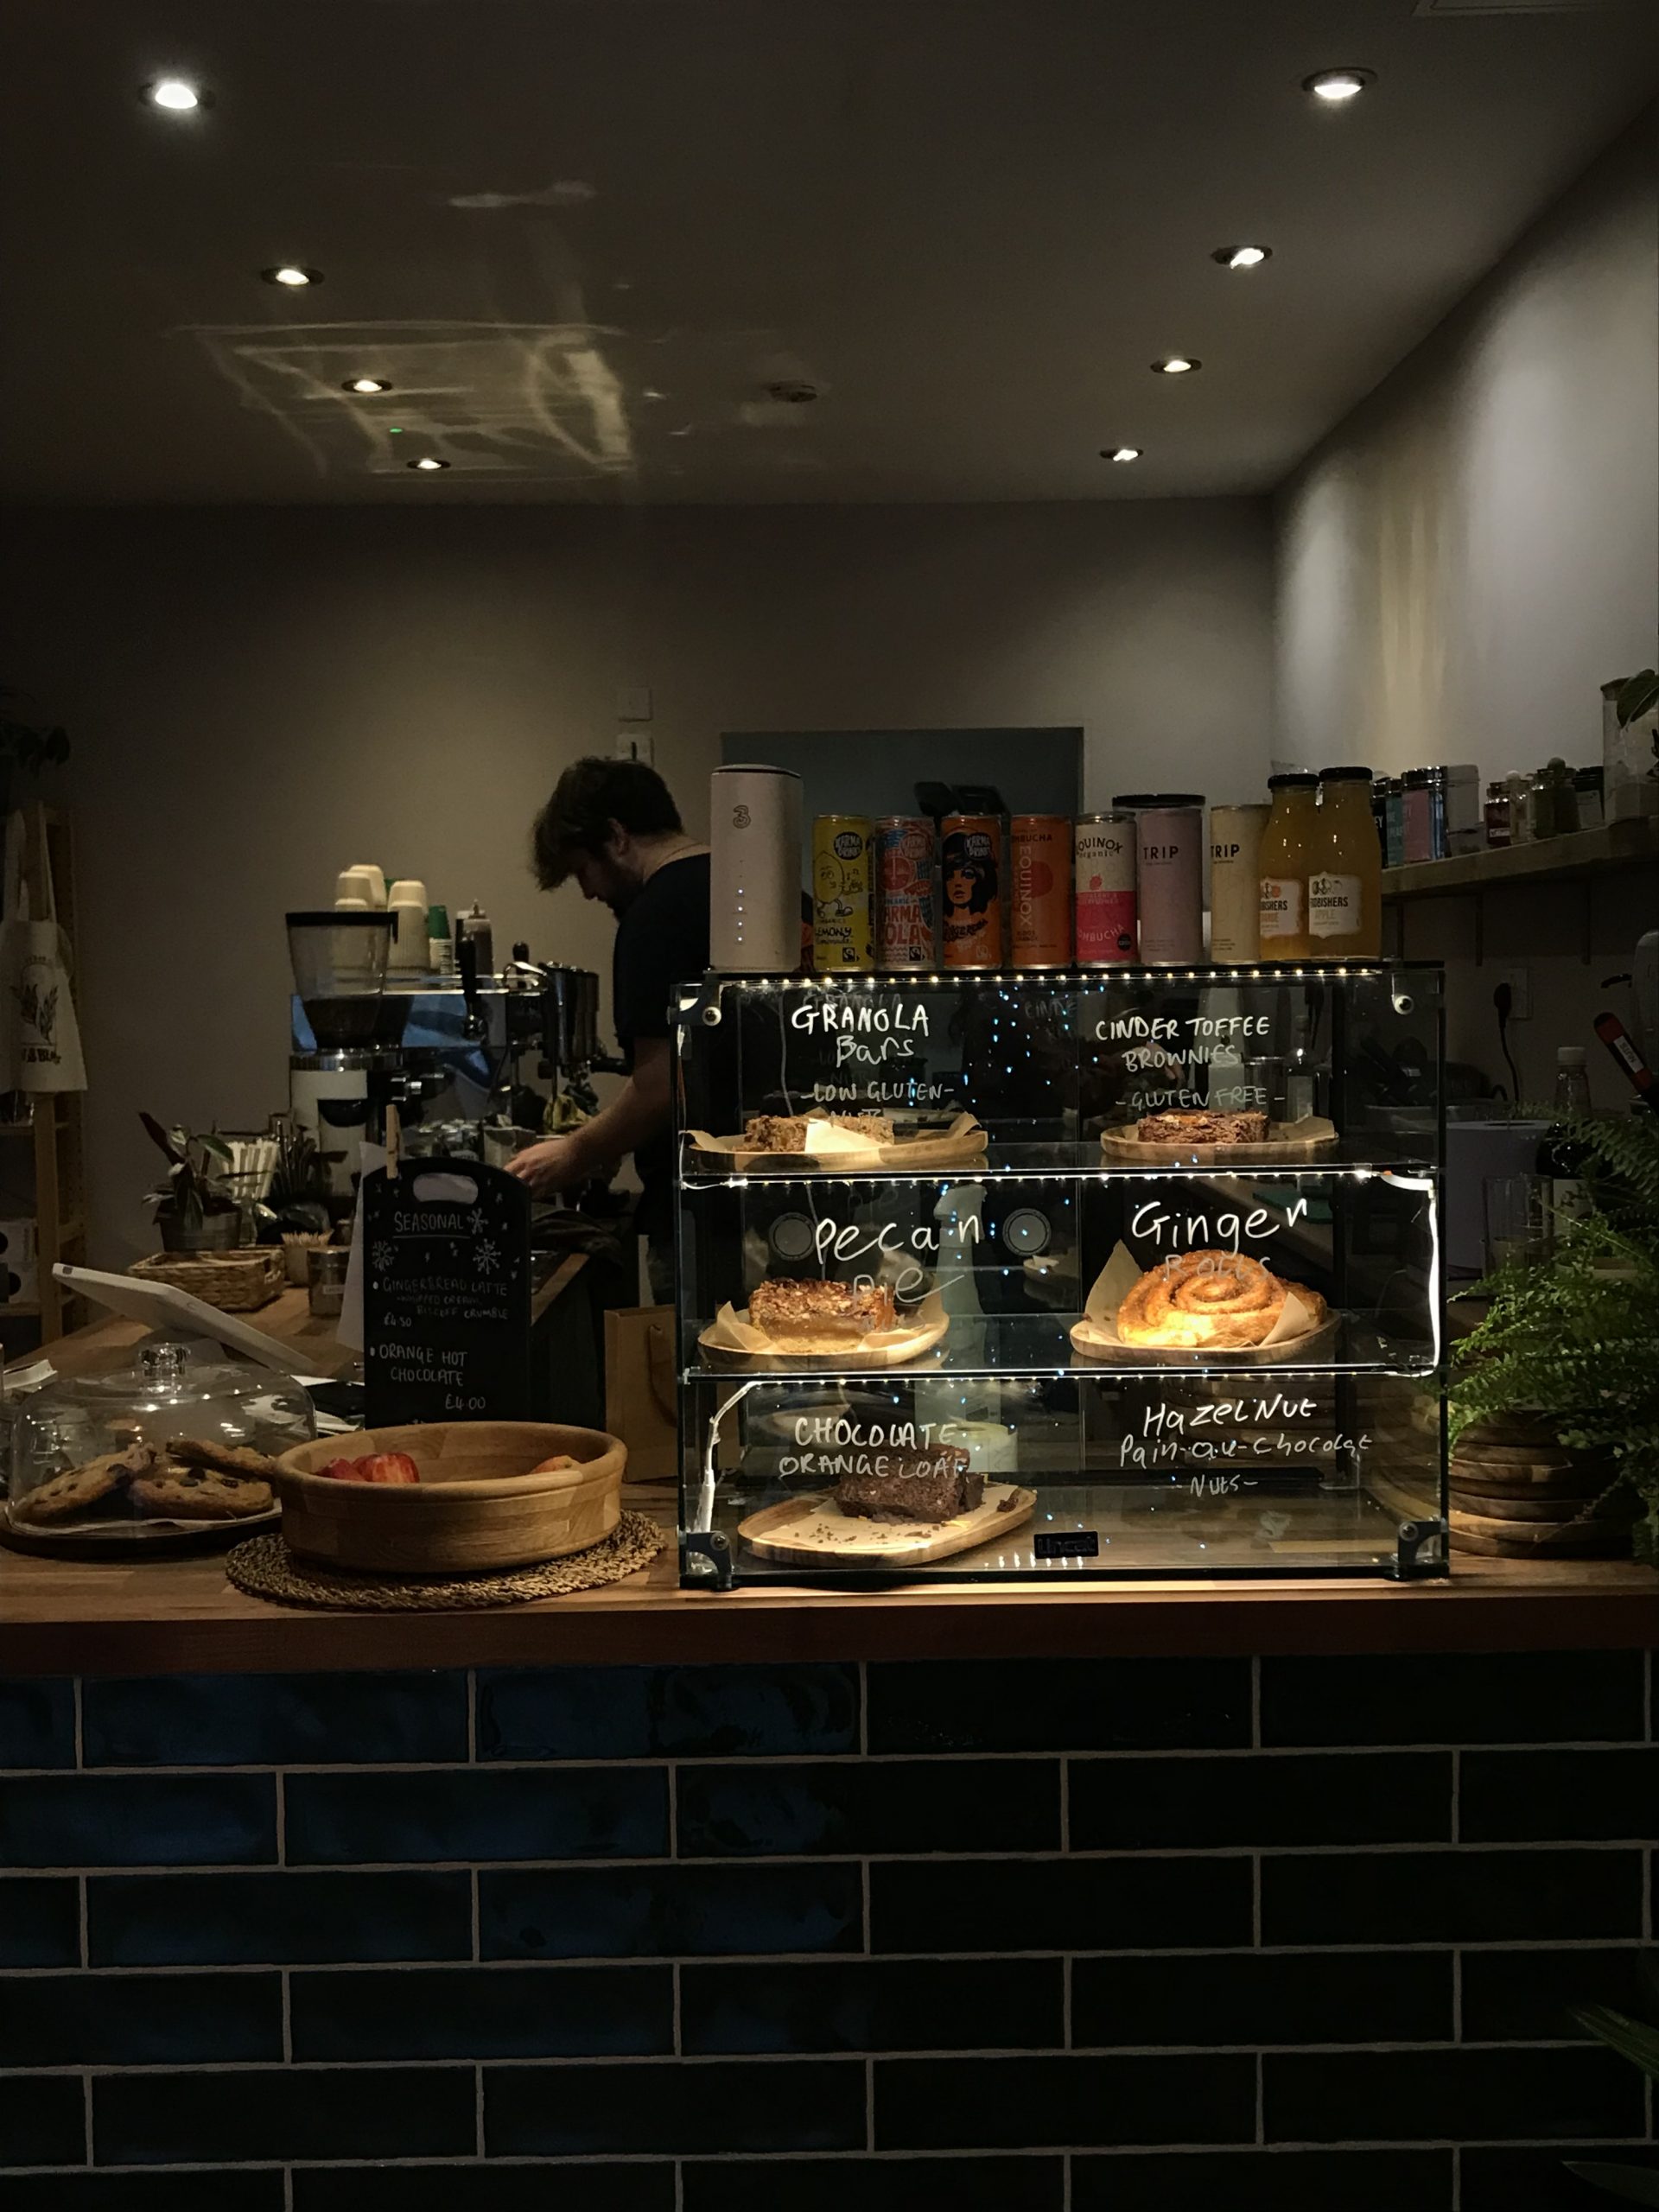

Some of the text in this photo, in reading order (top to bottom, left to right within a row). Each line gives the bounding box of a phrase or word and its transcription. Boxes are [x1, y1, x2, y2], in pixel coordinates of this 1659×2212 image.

[1077, 836, 1123, 854] QUINOX
[1143, 846, 1179, 860] TRIP
[881, 905, 922, 923] ARMA
[881, 922, 921, 945] OLA
[1077, 923, 1126, 943] OMBUCHA
[791, 1003, 930, 1037] GRANOLA
[1095, 1015, 1271, 1041] CINDER TOFFEE
[836, 1035, 915, 1069] Bars
[1122, 1044, 1239, 1073] BROWNIES
[393, 1211, 465, 1233] SEASONAL
[1131, 1198, 1307, 1259] Ginger
[379, 1343, 468, 1368] ORANGE HOT
[390, 1367, 464, 1387] CHOCOLATE
[794, 1416, 958, 1451] CHOCOLATE
[779, 1452, 889, 1480] ORANGE
